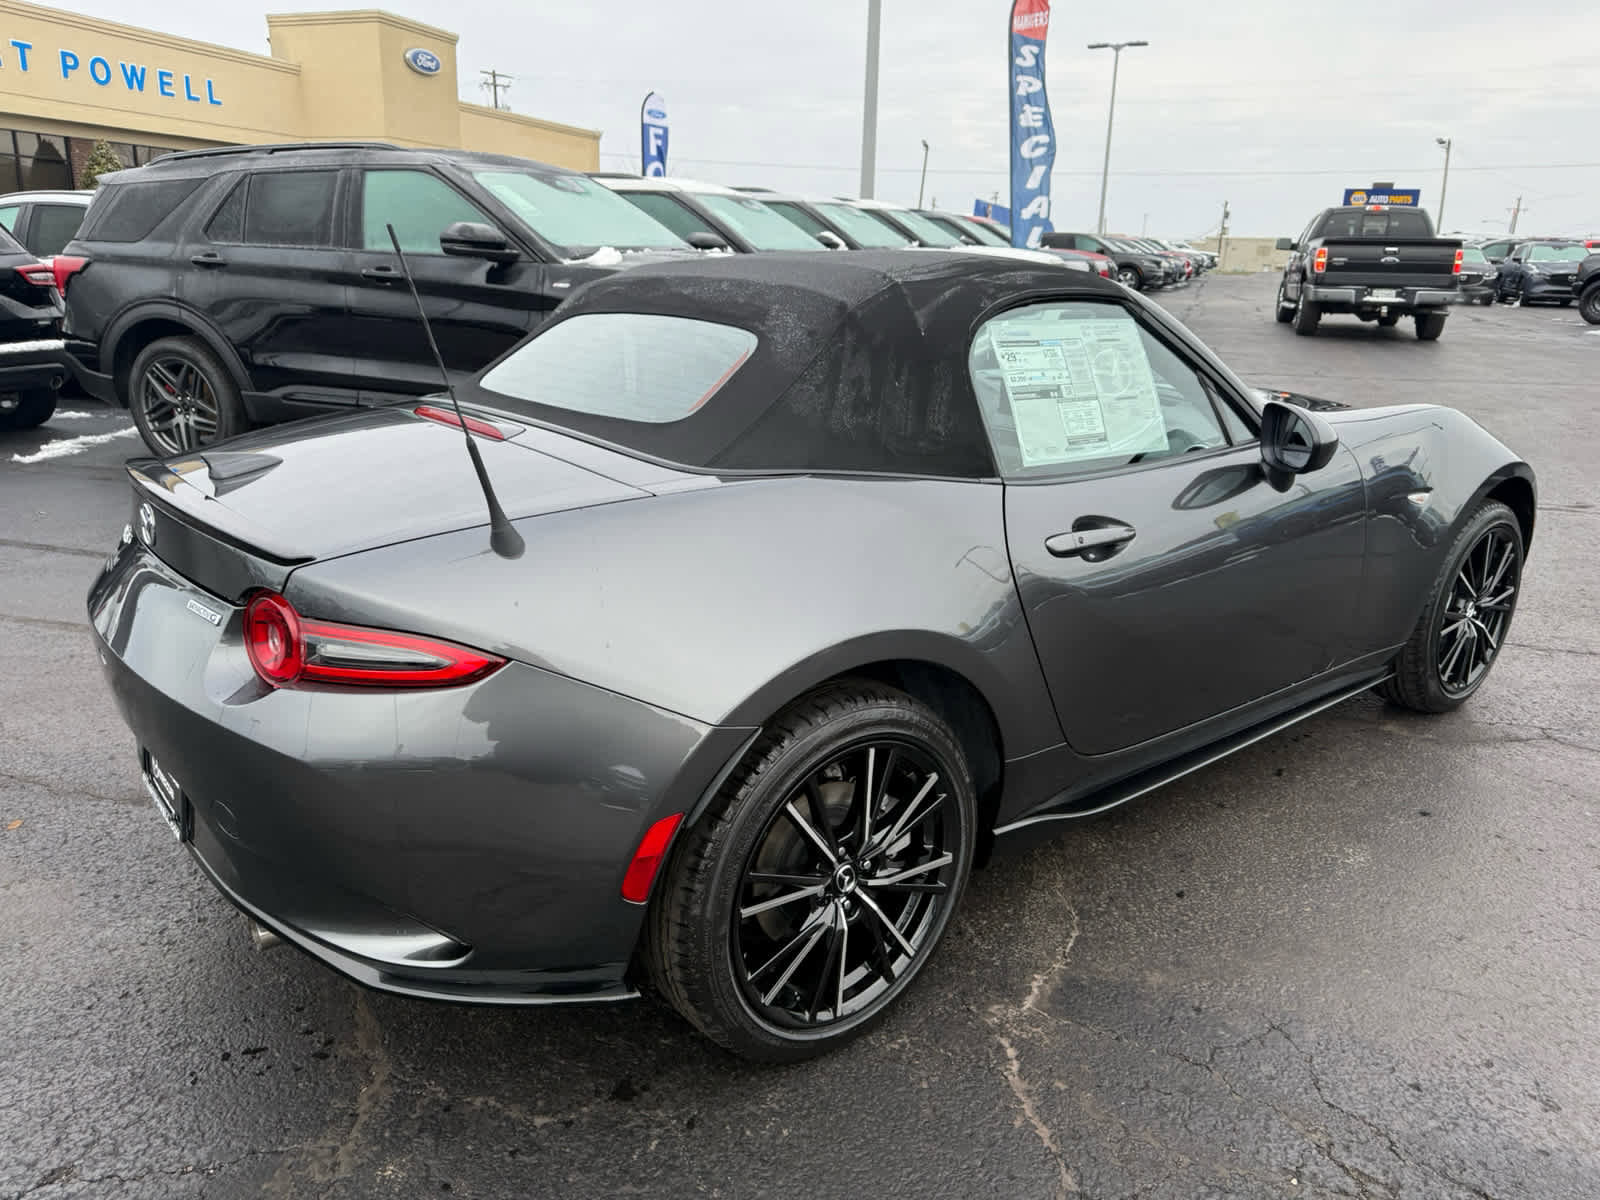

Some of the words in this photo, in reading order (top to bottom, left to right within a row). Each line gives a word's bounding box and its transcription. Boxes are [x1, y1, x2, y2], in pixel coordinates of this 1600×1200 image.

[0, 38, 33, 72] T
[59, 48, 223, 106] POWELL
[1014, 43, 1050, 249] SPECIAL
